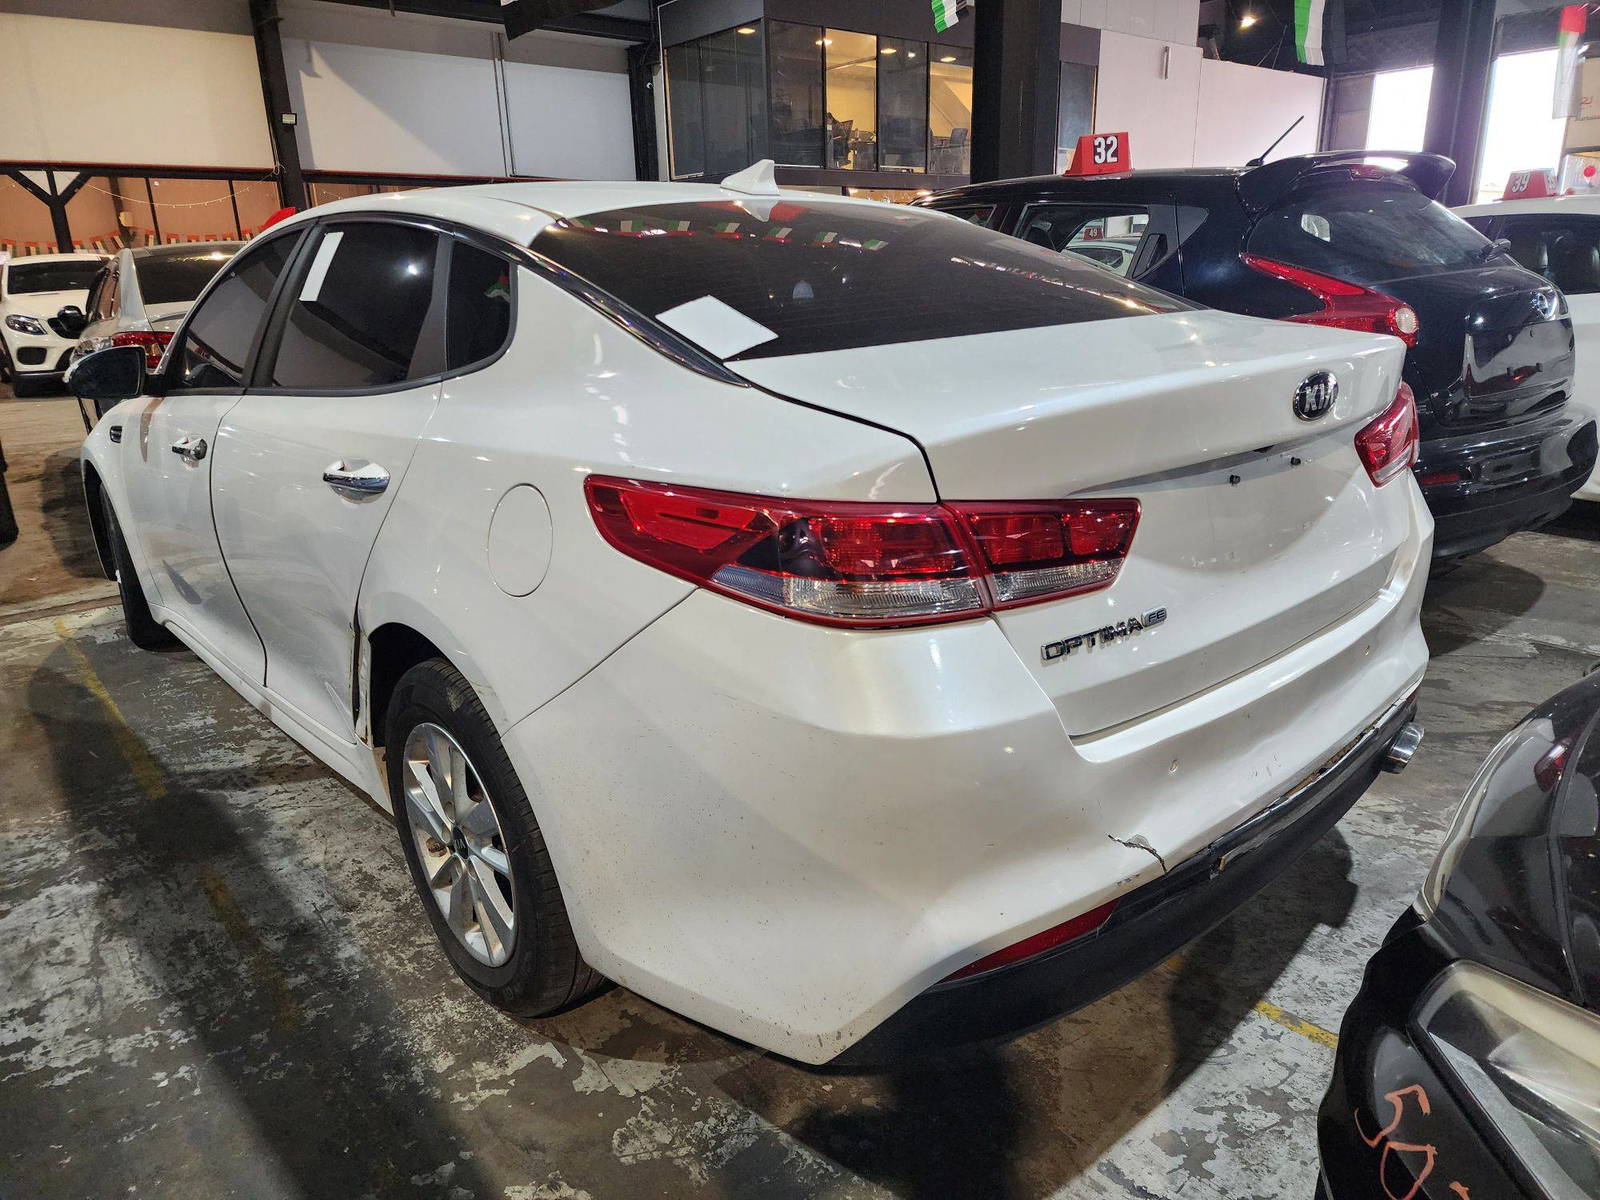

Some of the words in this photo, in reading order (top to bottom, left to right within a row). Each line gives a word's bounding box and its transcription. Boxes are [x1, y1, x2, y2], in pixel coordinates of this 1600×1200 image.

[1094, 135, 1118, 164] 32
[1512, 172, 1531, 193] 39
[1088, 228, 1098, 238] 49
[1041, 616, 1144, 661] OPTIMA
[1147, 608, 1166, 624] FE
